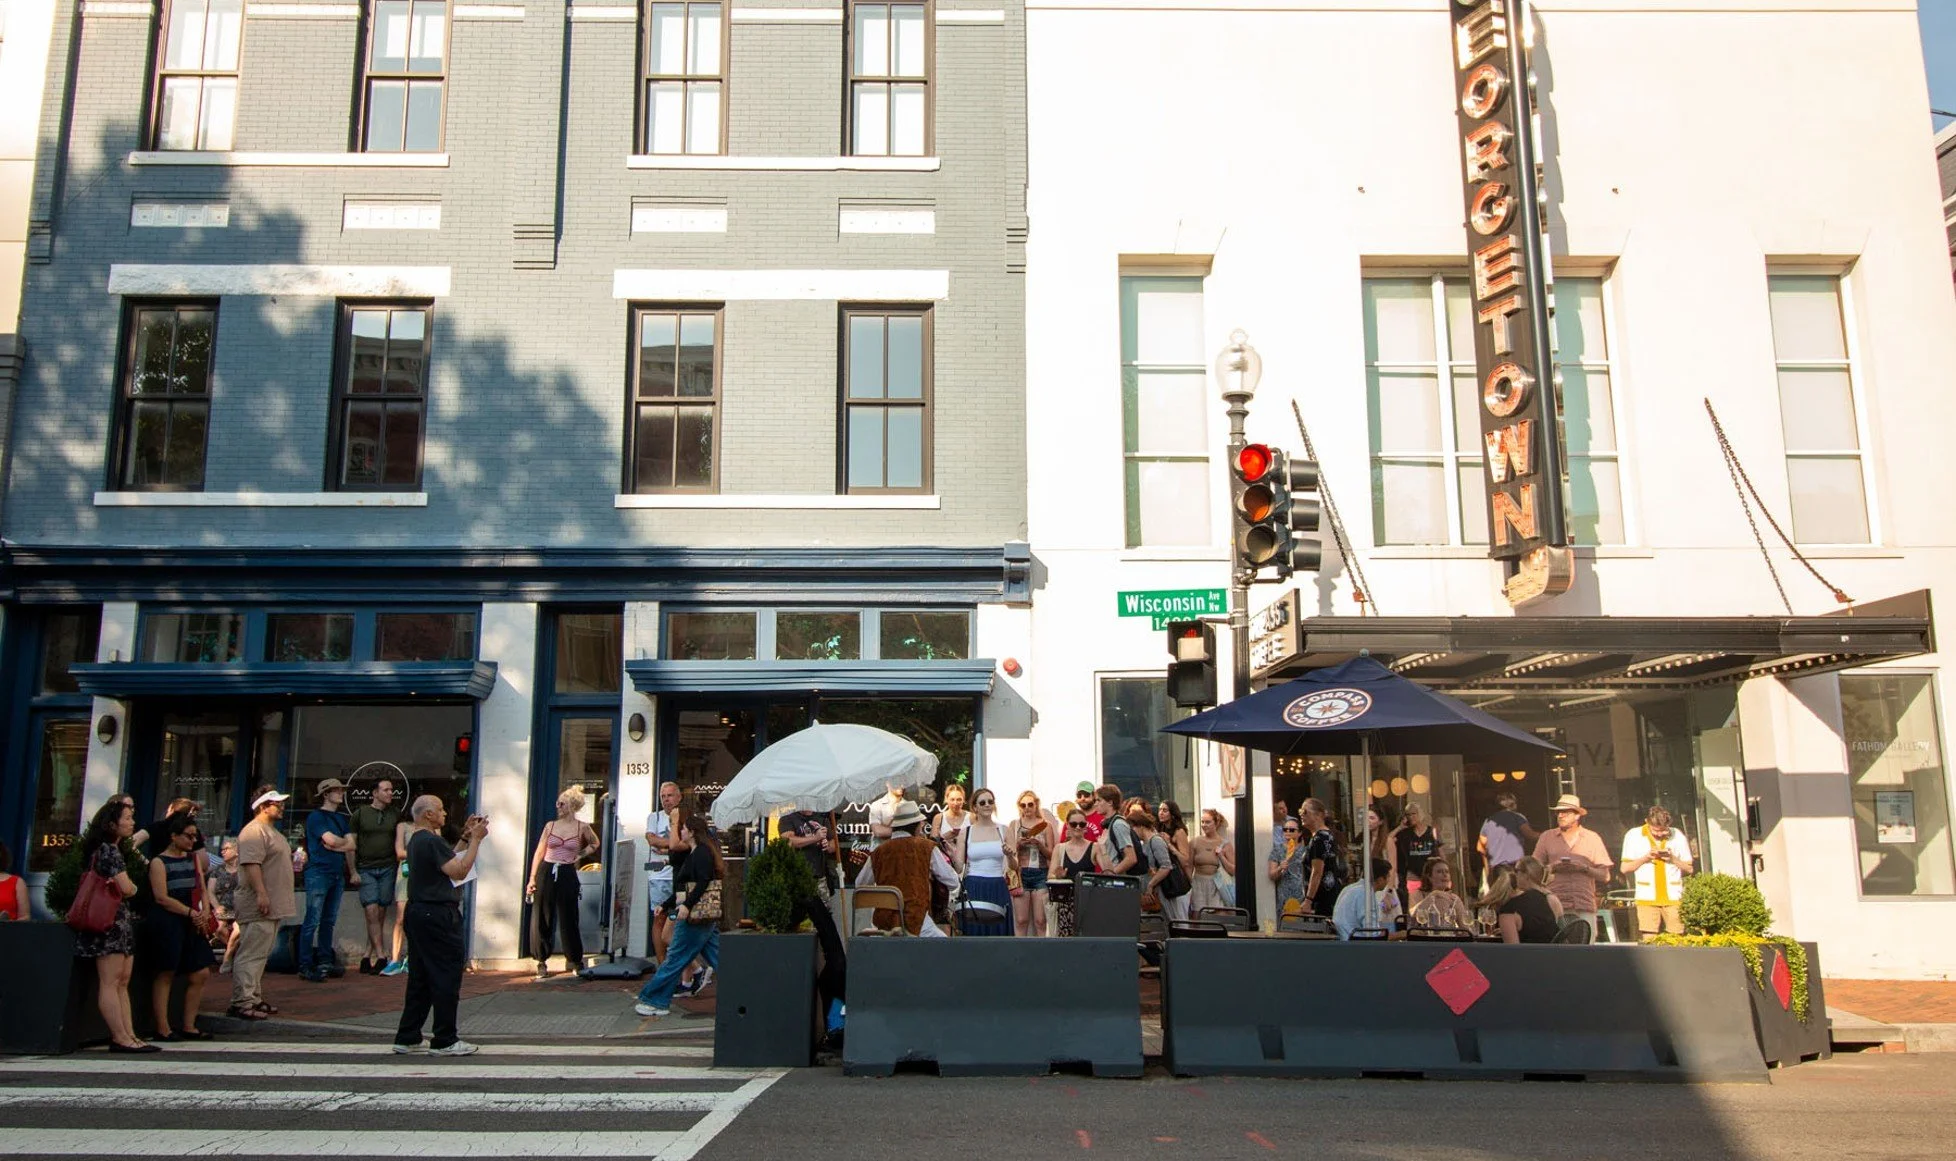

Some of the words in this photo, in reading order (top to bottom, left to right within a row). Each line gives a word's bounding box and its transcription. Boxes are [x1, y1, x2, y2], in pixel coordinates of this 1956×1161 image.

[1455, 0, 1541, 548] EORGETOWN
[1125, 594, 1206, 614] Wisconsin
[1208, 591, 1220, 601] Ave
[1299, 691, 1365, 707] COMPASS
[1291, 713, 1353, 725] COFFEE
[626, 763, 650, 775] 1353
[42, 834, 73, 847] 1355
